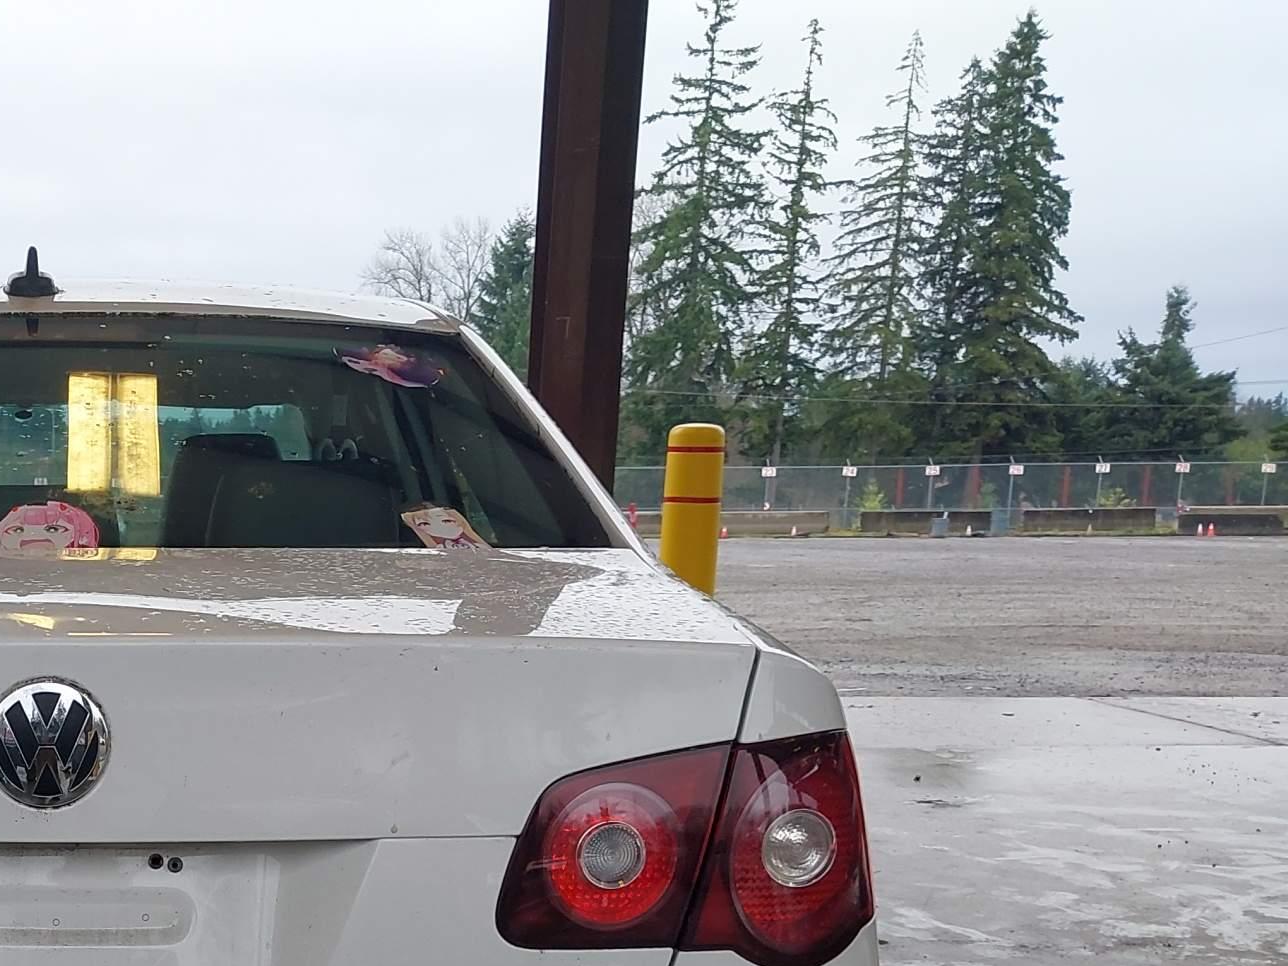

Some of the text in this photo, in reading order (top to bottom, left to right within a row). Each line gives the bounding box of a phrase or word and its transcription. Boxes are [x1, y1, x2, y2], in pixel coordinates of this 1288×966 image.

[763, 467, 775, 476] 23
[844, 467, 856, 476] 24
[926, 466, 938, 475] 25
[1097, 464, 1109, 473] 27
